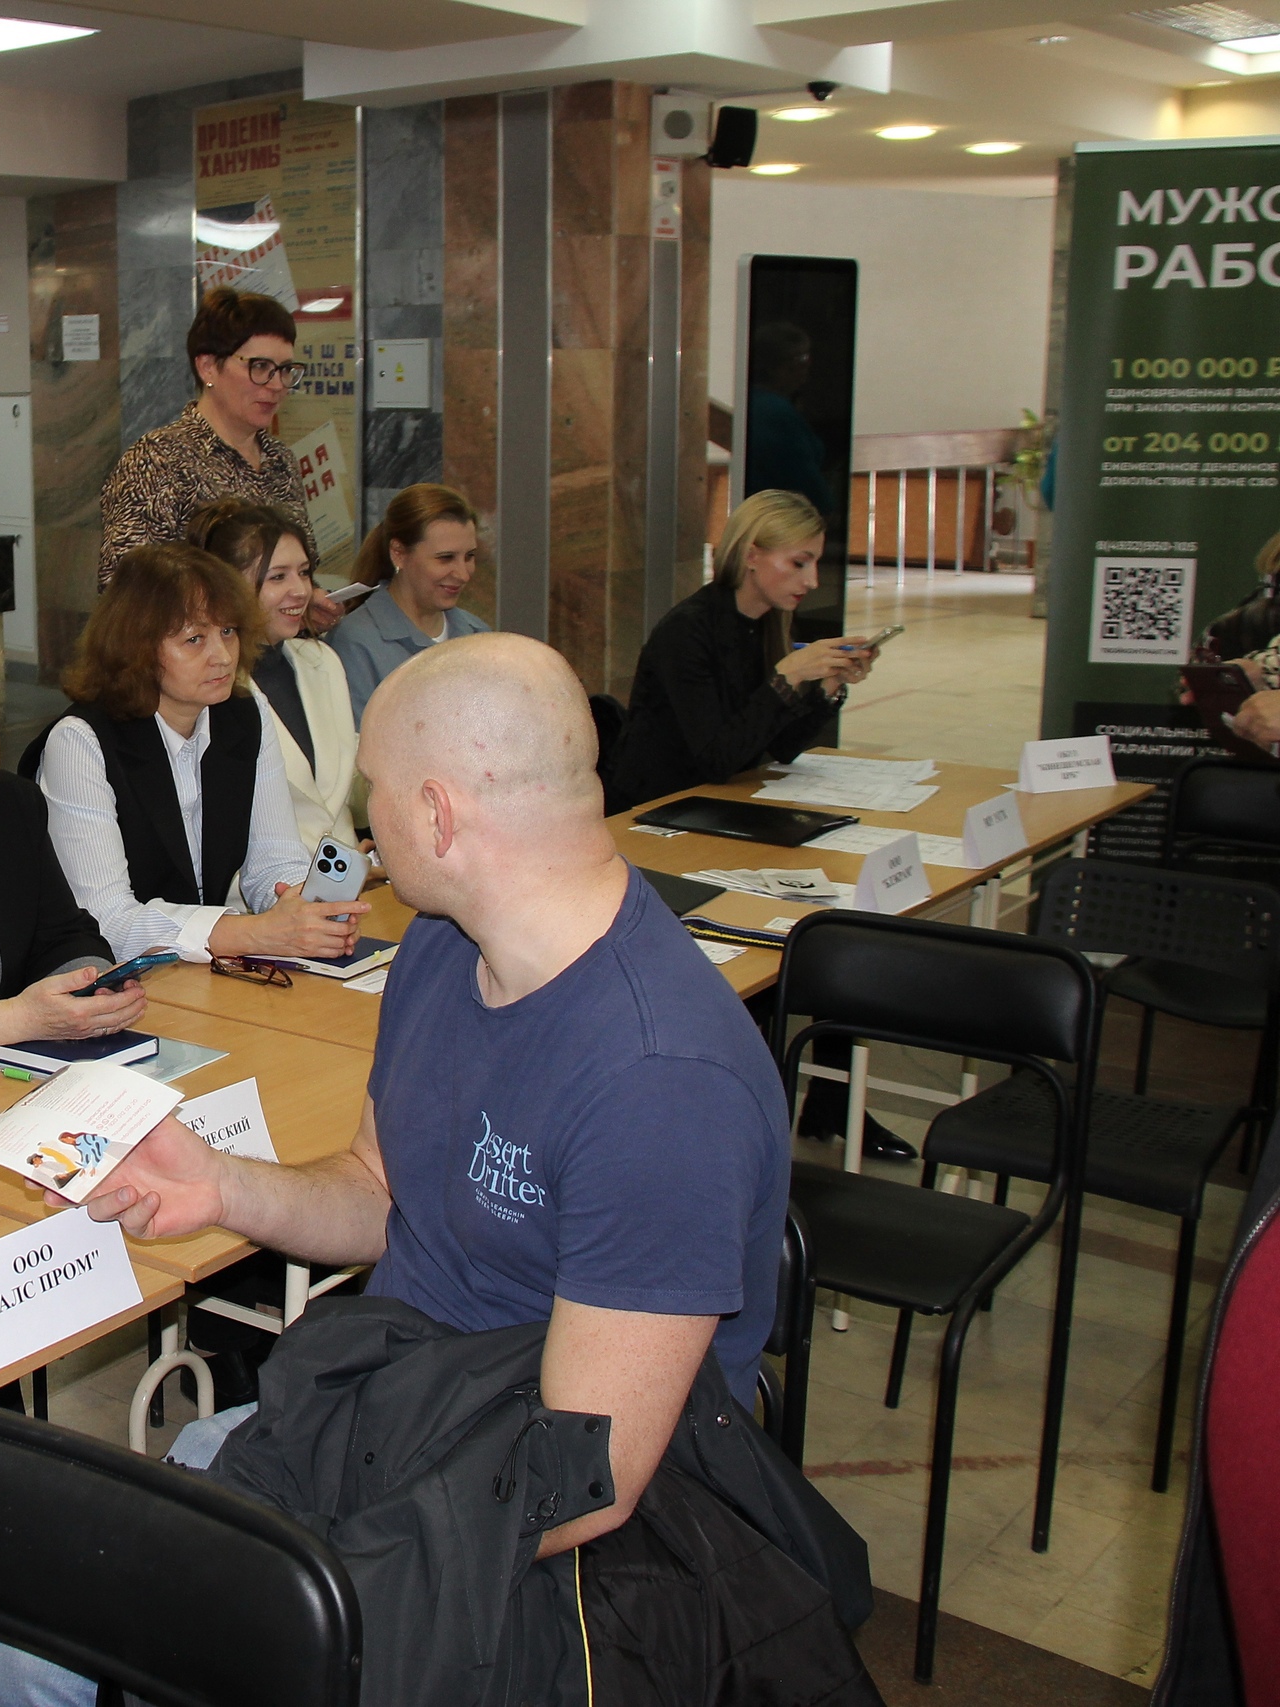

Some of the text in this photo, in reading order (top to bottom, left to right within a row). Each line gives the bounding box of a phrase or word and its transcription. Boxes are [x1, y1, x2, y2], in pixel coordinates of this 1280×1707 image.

[199, 144, 281, 178] ХАНУМЫ
[1111, 357, 1258, 379] 1 000 000
[1103, 432, 1270, 453] от 204 000
[1095, 724, 1211, 739] СОЦИАЛЬНЫЕ
[467, 1146, 546, 1207] Drifter
[12, 1243, 54, 1275] ООО
[39, 1250, 100, 1293] ПРОМ"
